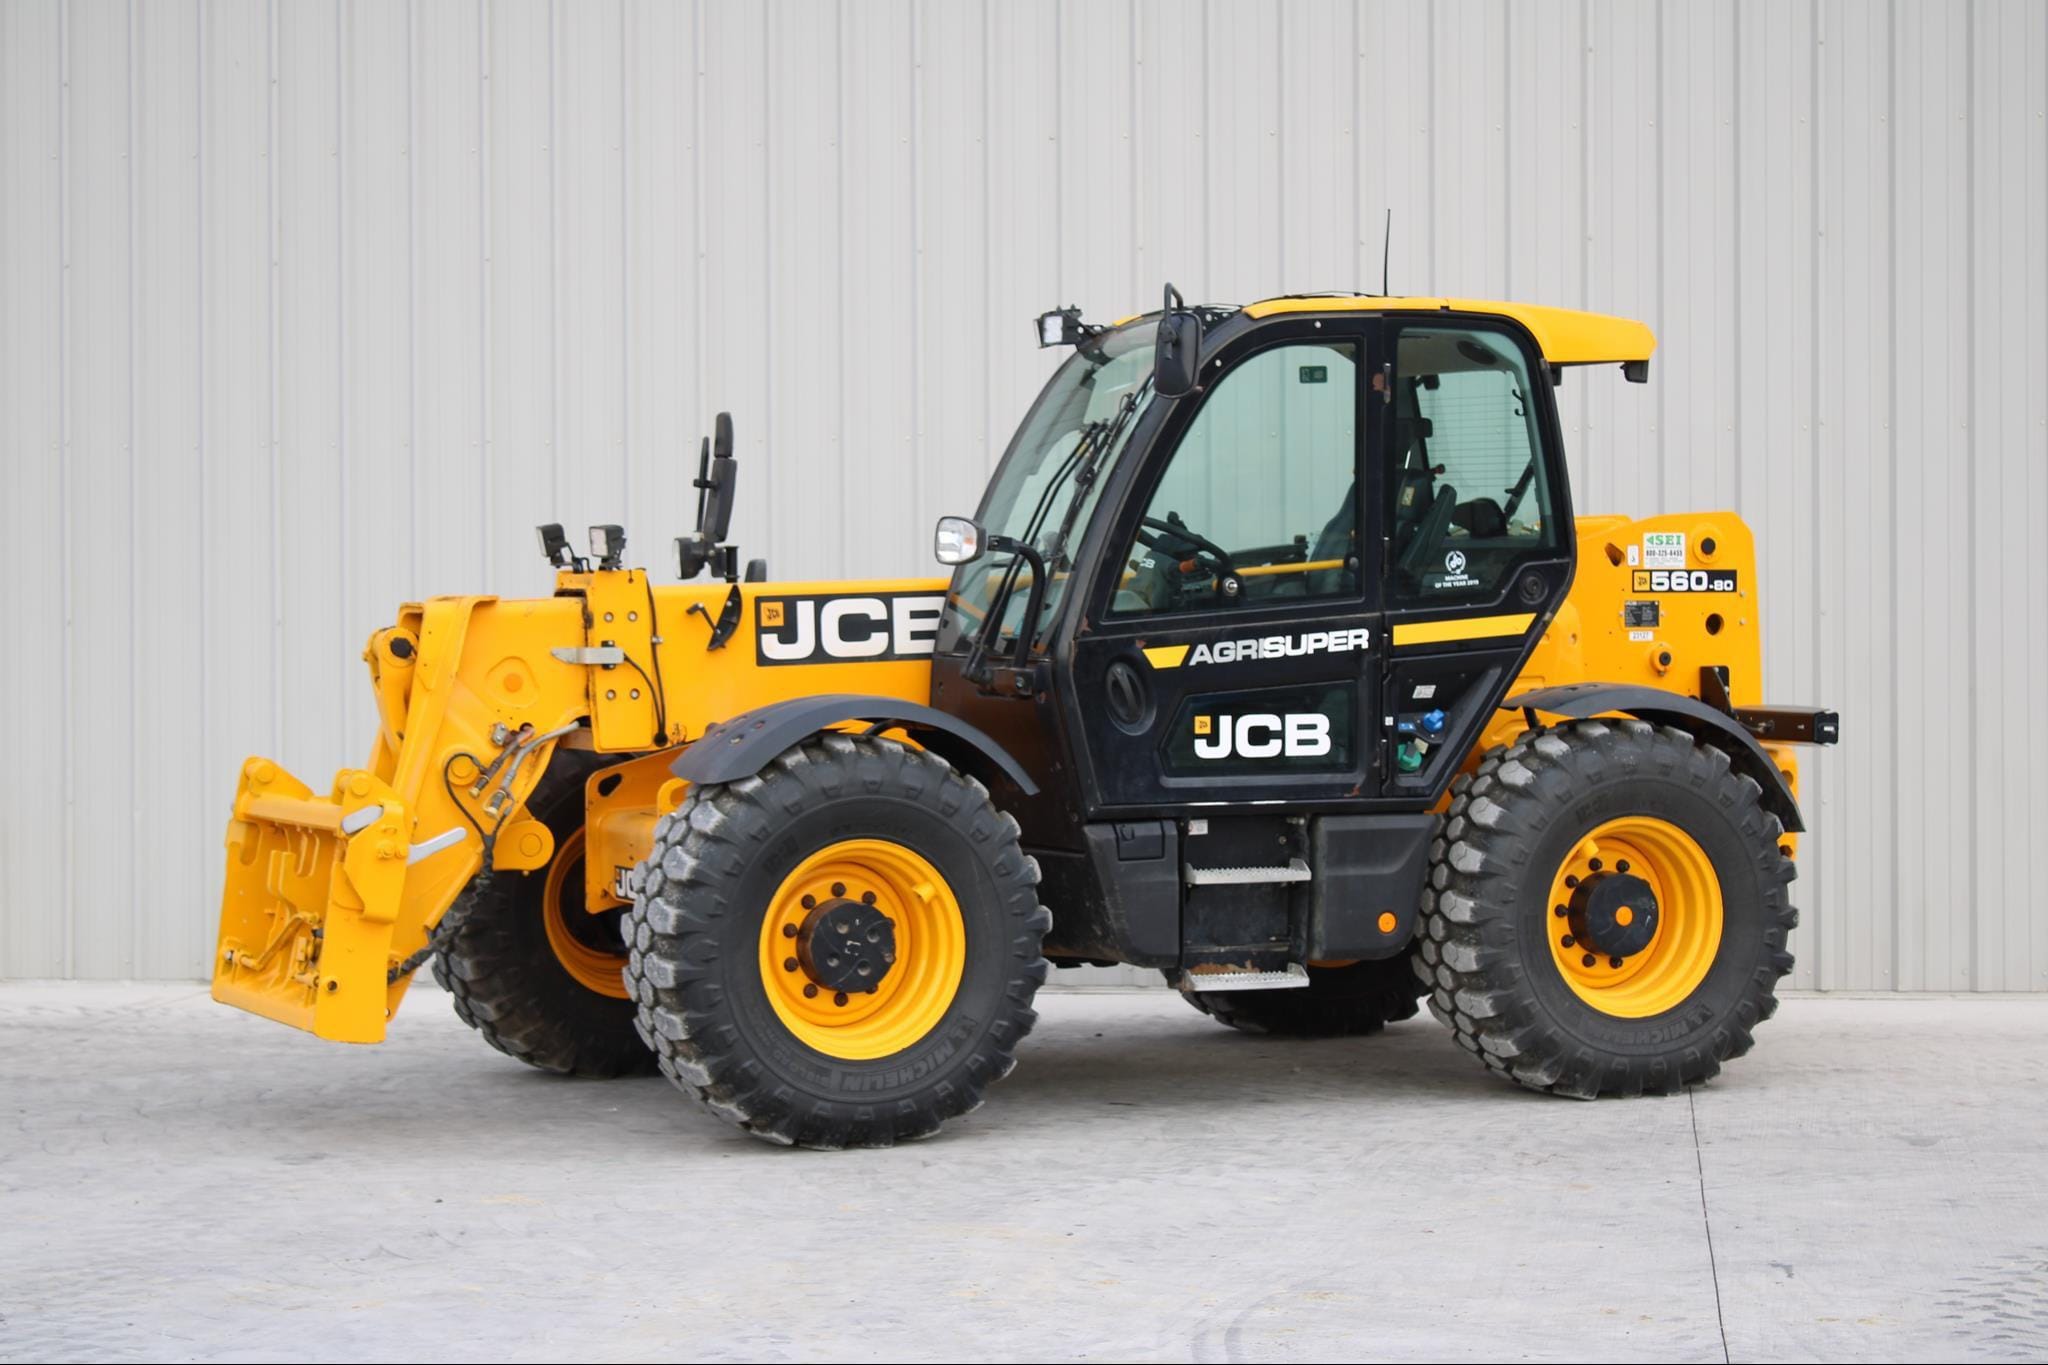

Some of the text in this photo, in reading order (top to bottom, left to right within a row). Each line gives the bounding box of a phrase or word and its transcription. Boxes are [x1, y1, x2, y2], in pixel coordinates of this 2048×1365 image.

[1655, 535, 1682, 546] SEI
[1188, 628, 1370, 666] AGRISUPER
[1194, 713, 1332, 760] JCB
[840, 1038, 956, 1091] MICHELIN
